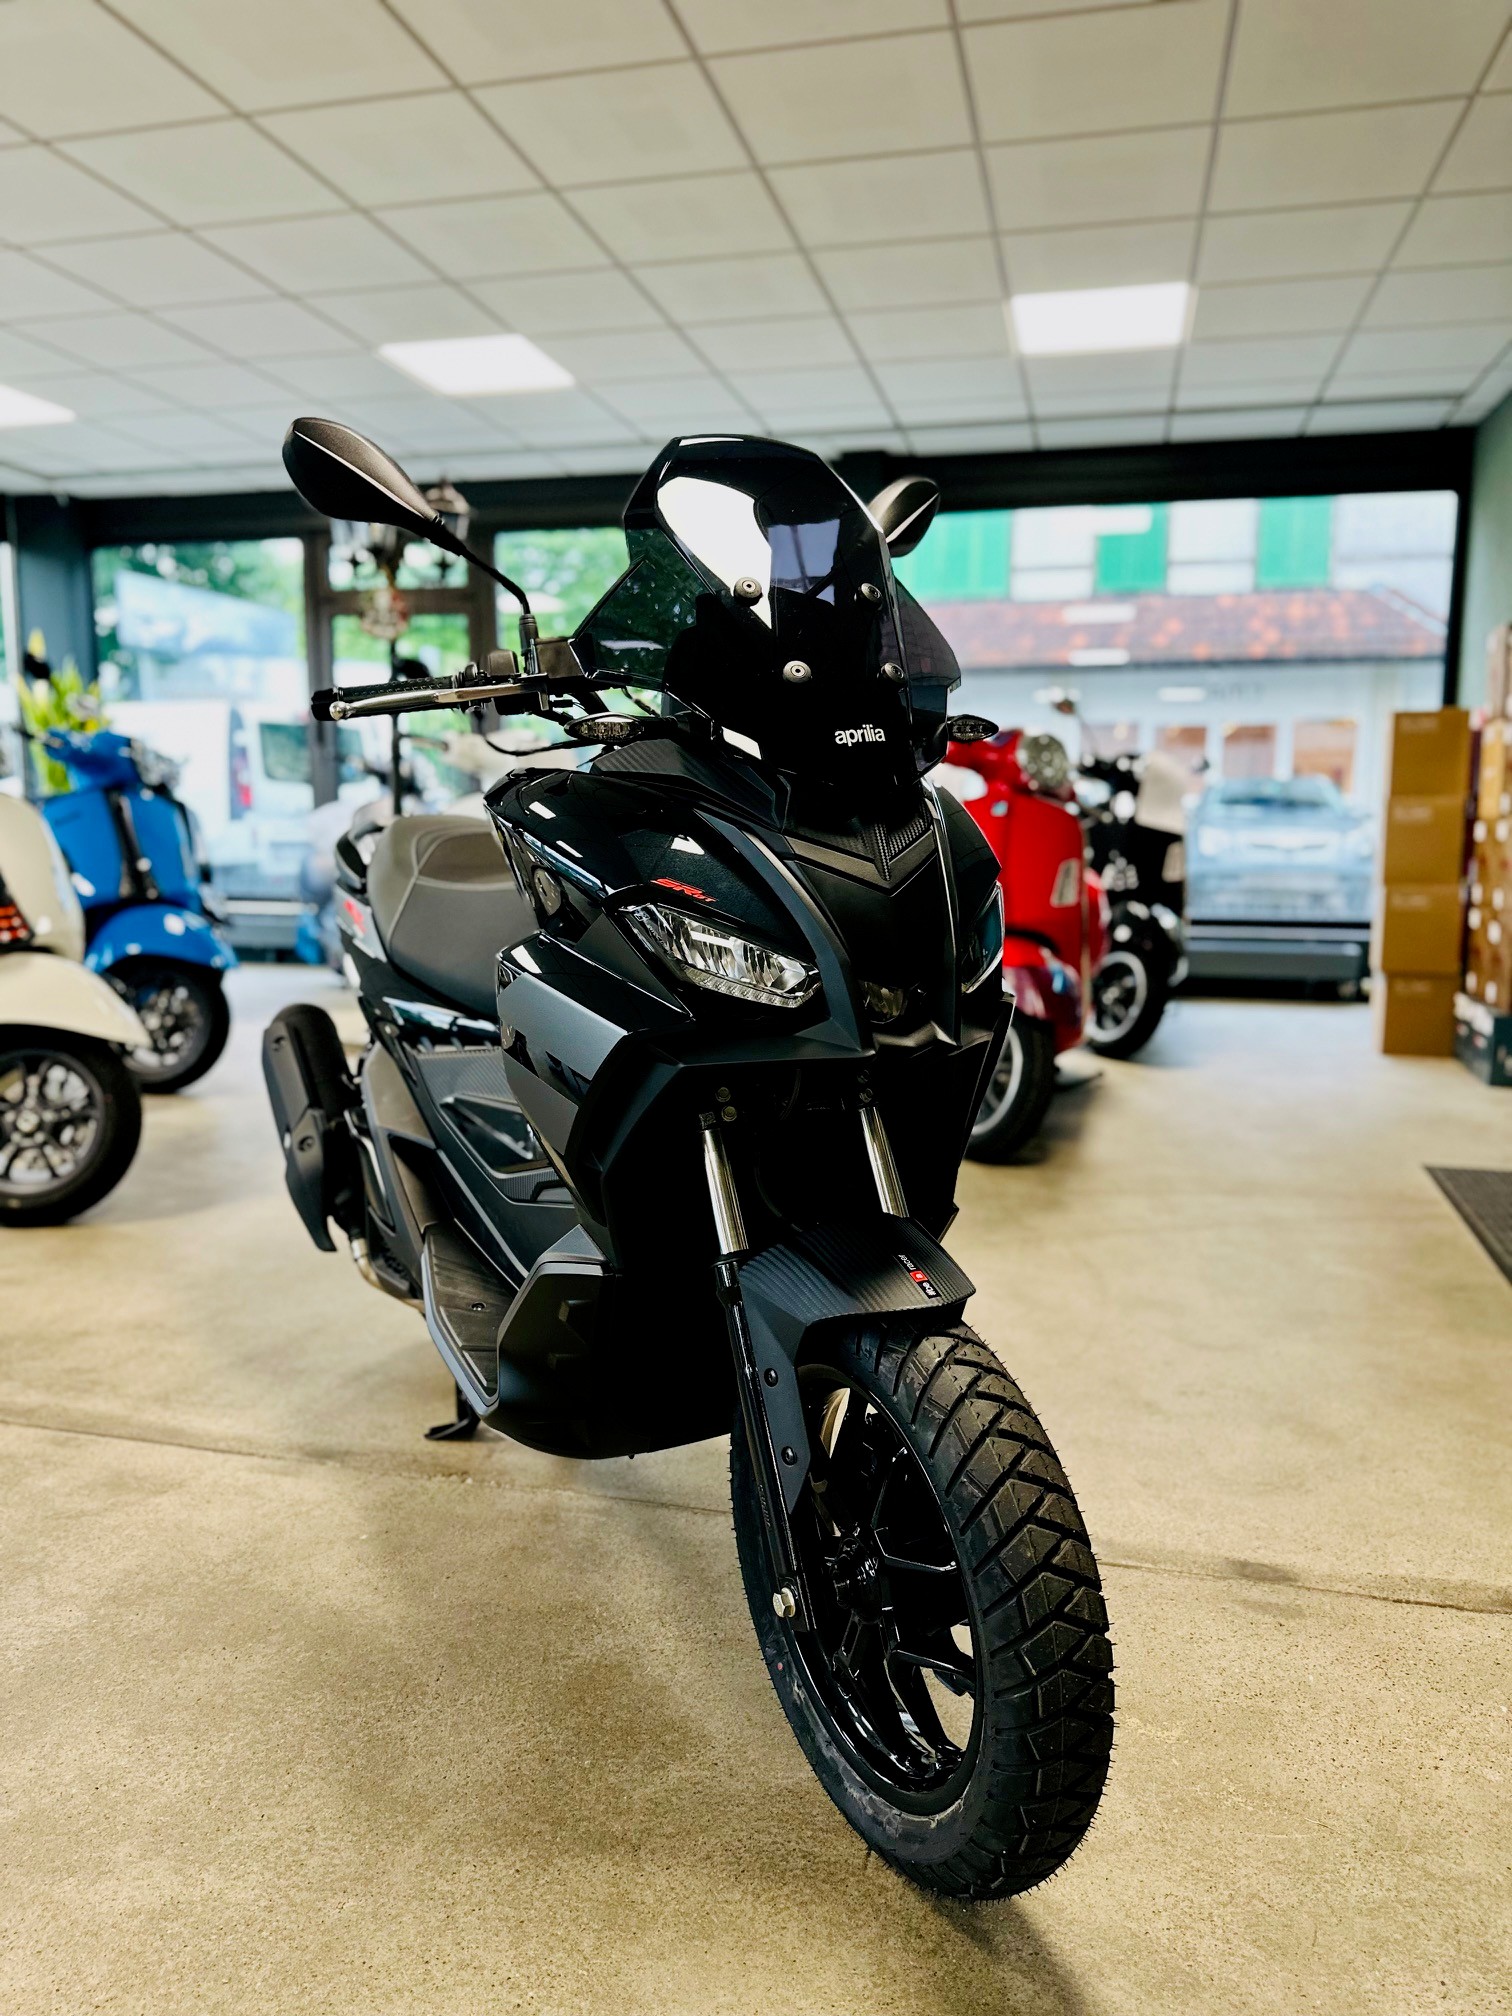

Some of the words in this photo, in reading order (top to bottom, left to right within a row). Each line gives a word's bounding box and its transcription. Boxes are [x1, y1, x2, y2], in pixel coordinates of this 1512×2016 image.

[834, 723, 886, 747] aprilia
[650, 877, 704, 896] SR
[898, 1254, 917, 1271] racer
